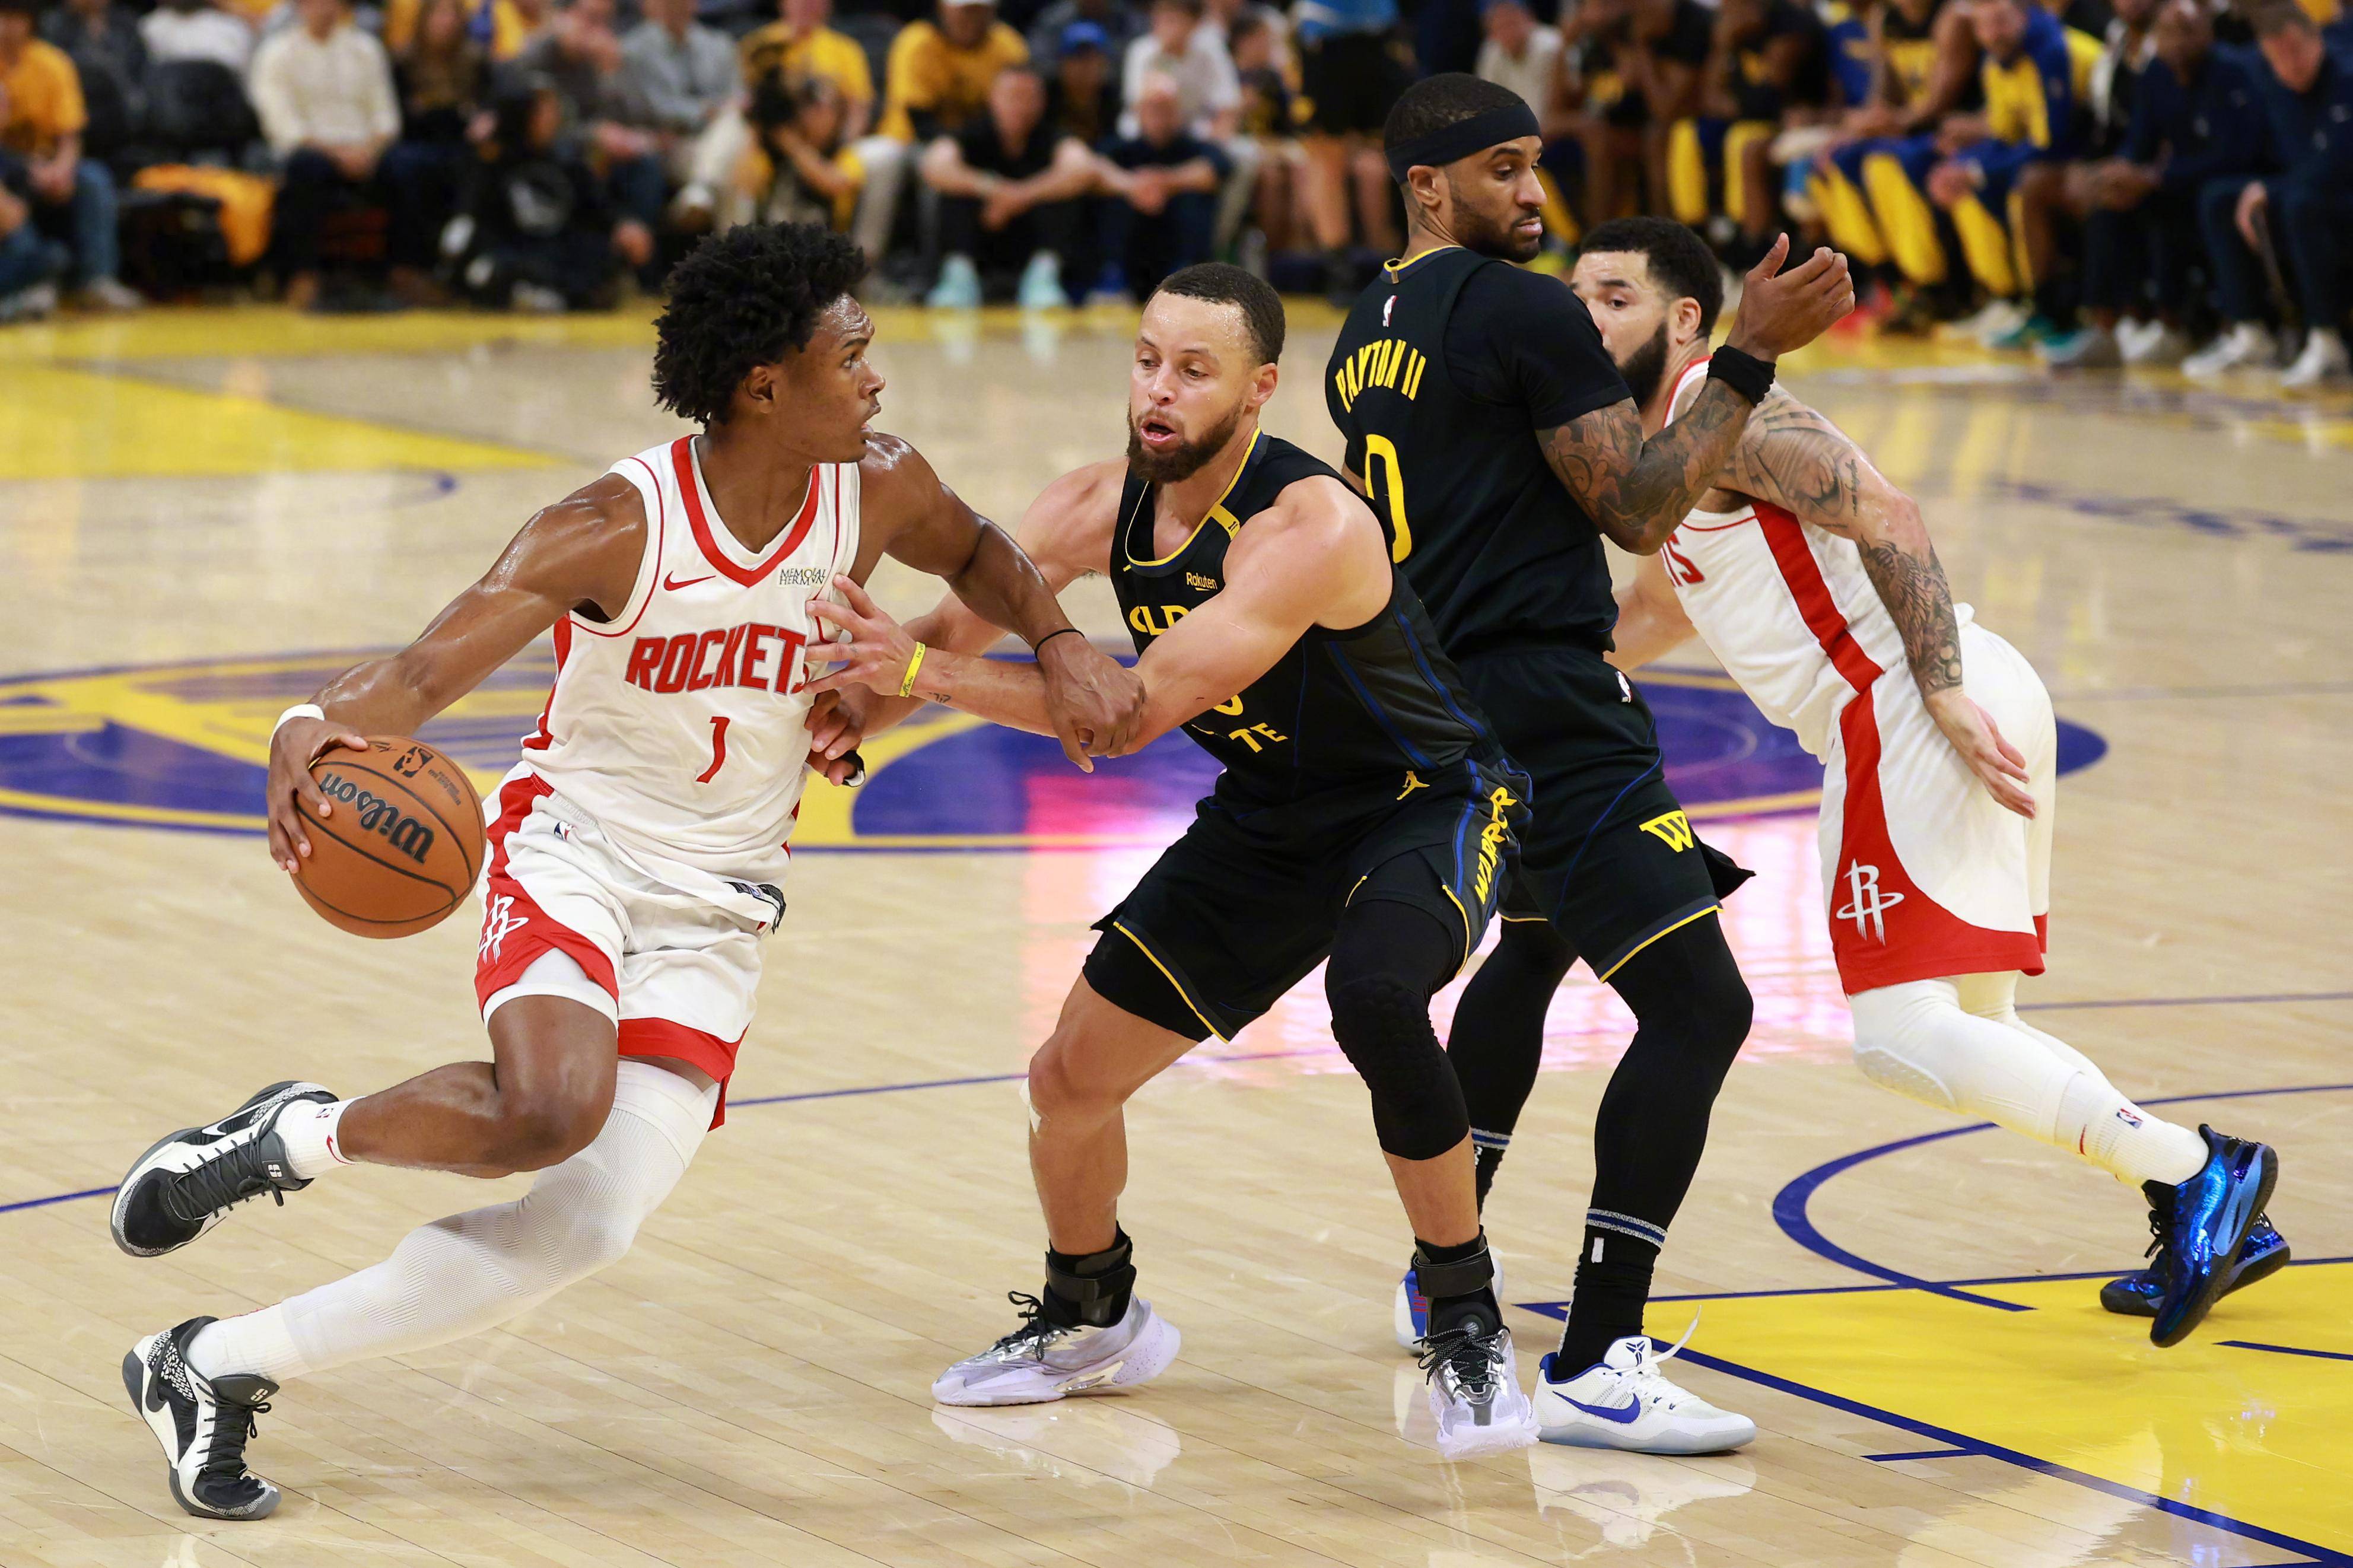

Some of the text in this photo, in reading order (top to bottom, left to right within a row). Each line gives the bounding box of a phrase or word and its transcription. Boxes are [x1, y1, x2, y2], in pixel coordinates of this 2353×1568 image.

[1336, 339, 1407, 414] PAYTON
[1186, 572, 1217, 590] Rakuten
[696, 716, 730, 784] 1
[319, 772, 435, 865] Wilson
